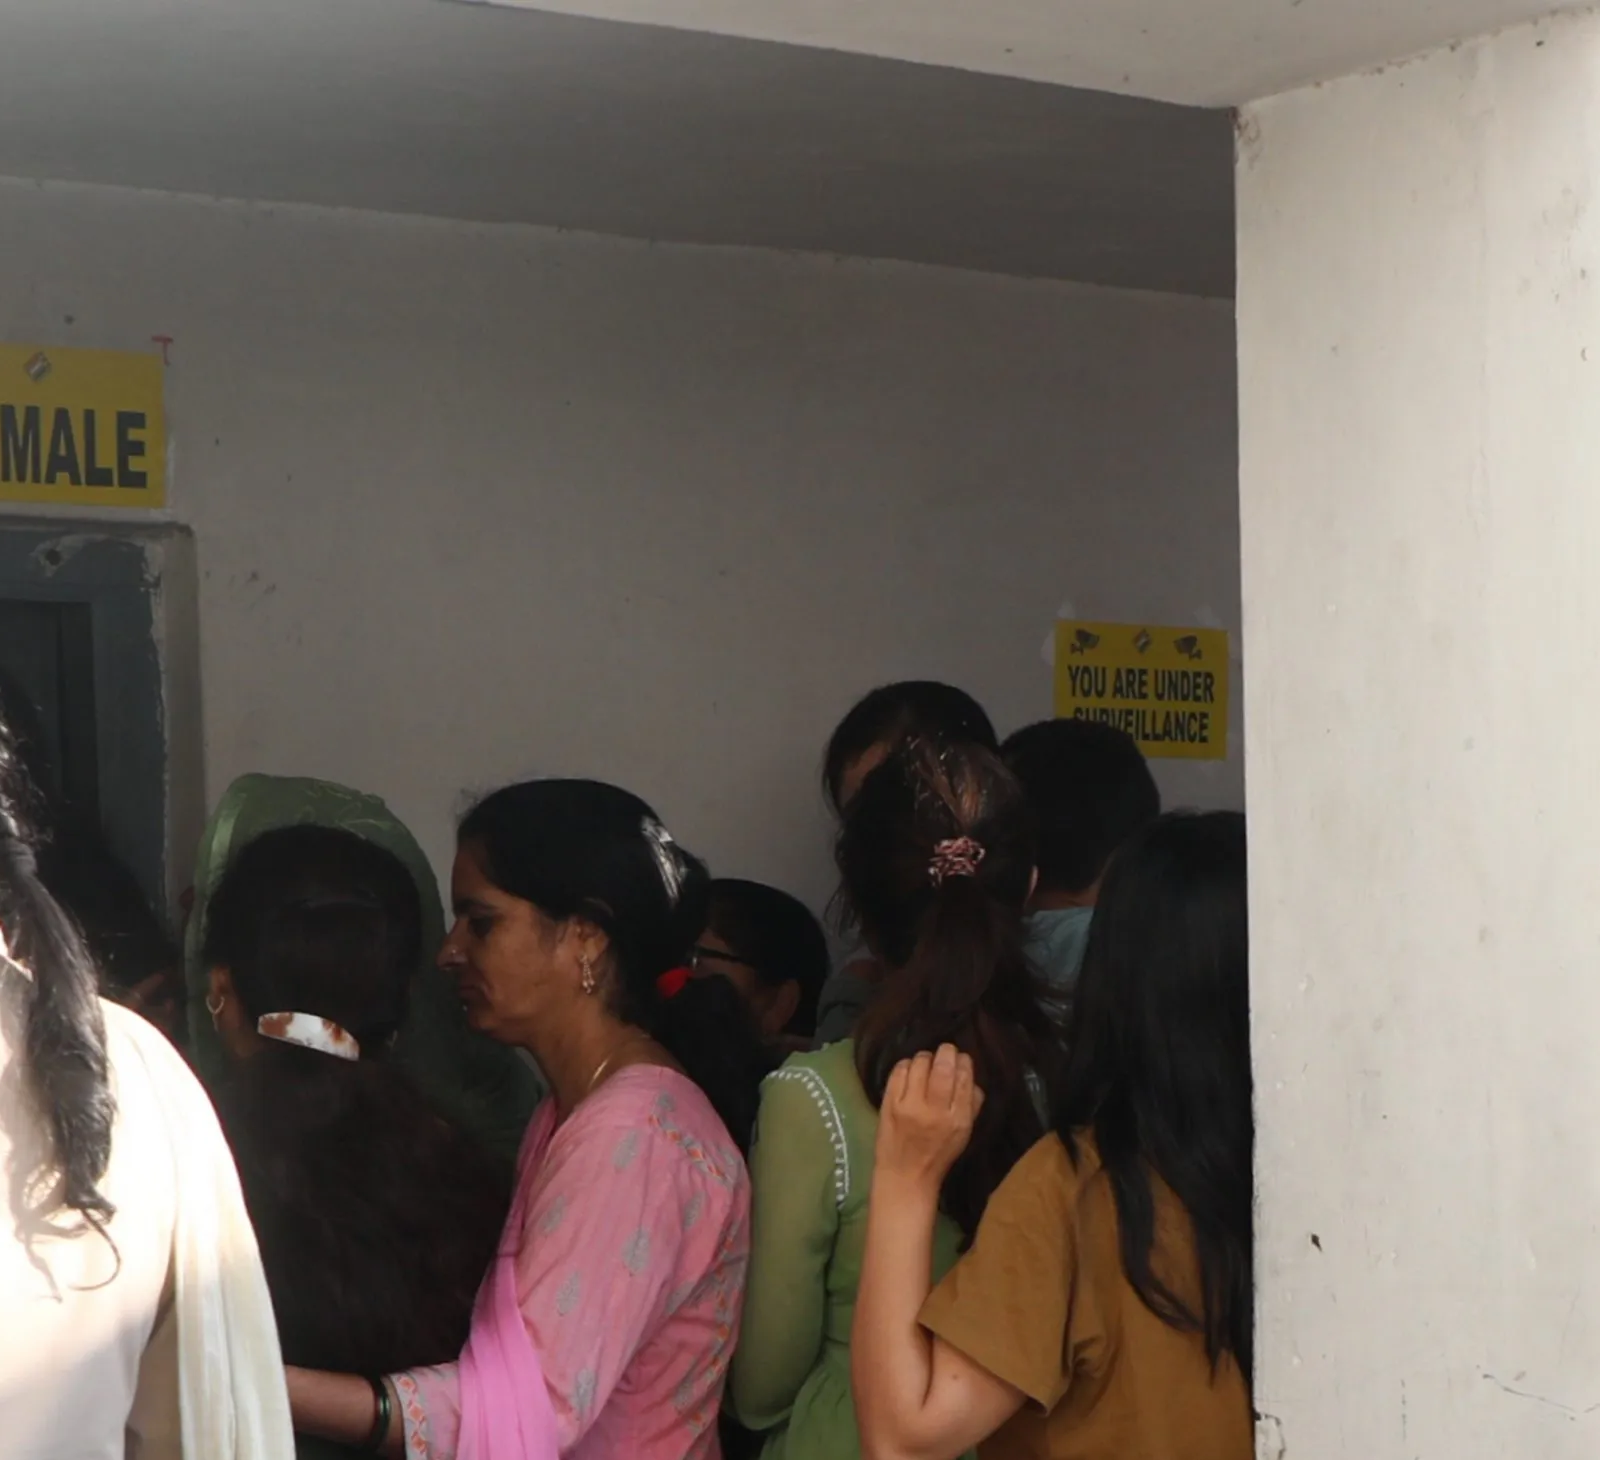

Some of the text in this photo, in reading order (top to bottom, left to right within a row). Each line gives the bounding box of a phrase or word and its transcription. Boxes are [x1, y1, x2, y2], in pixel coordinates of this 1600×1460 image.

[1067, 664, 1215, 704] YOU ARE UNDER
